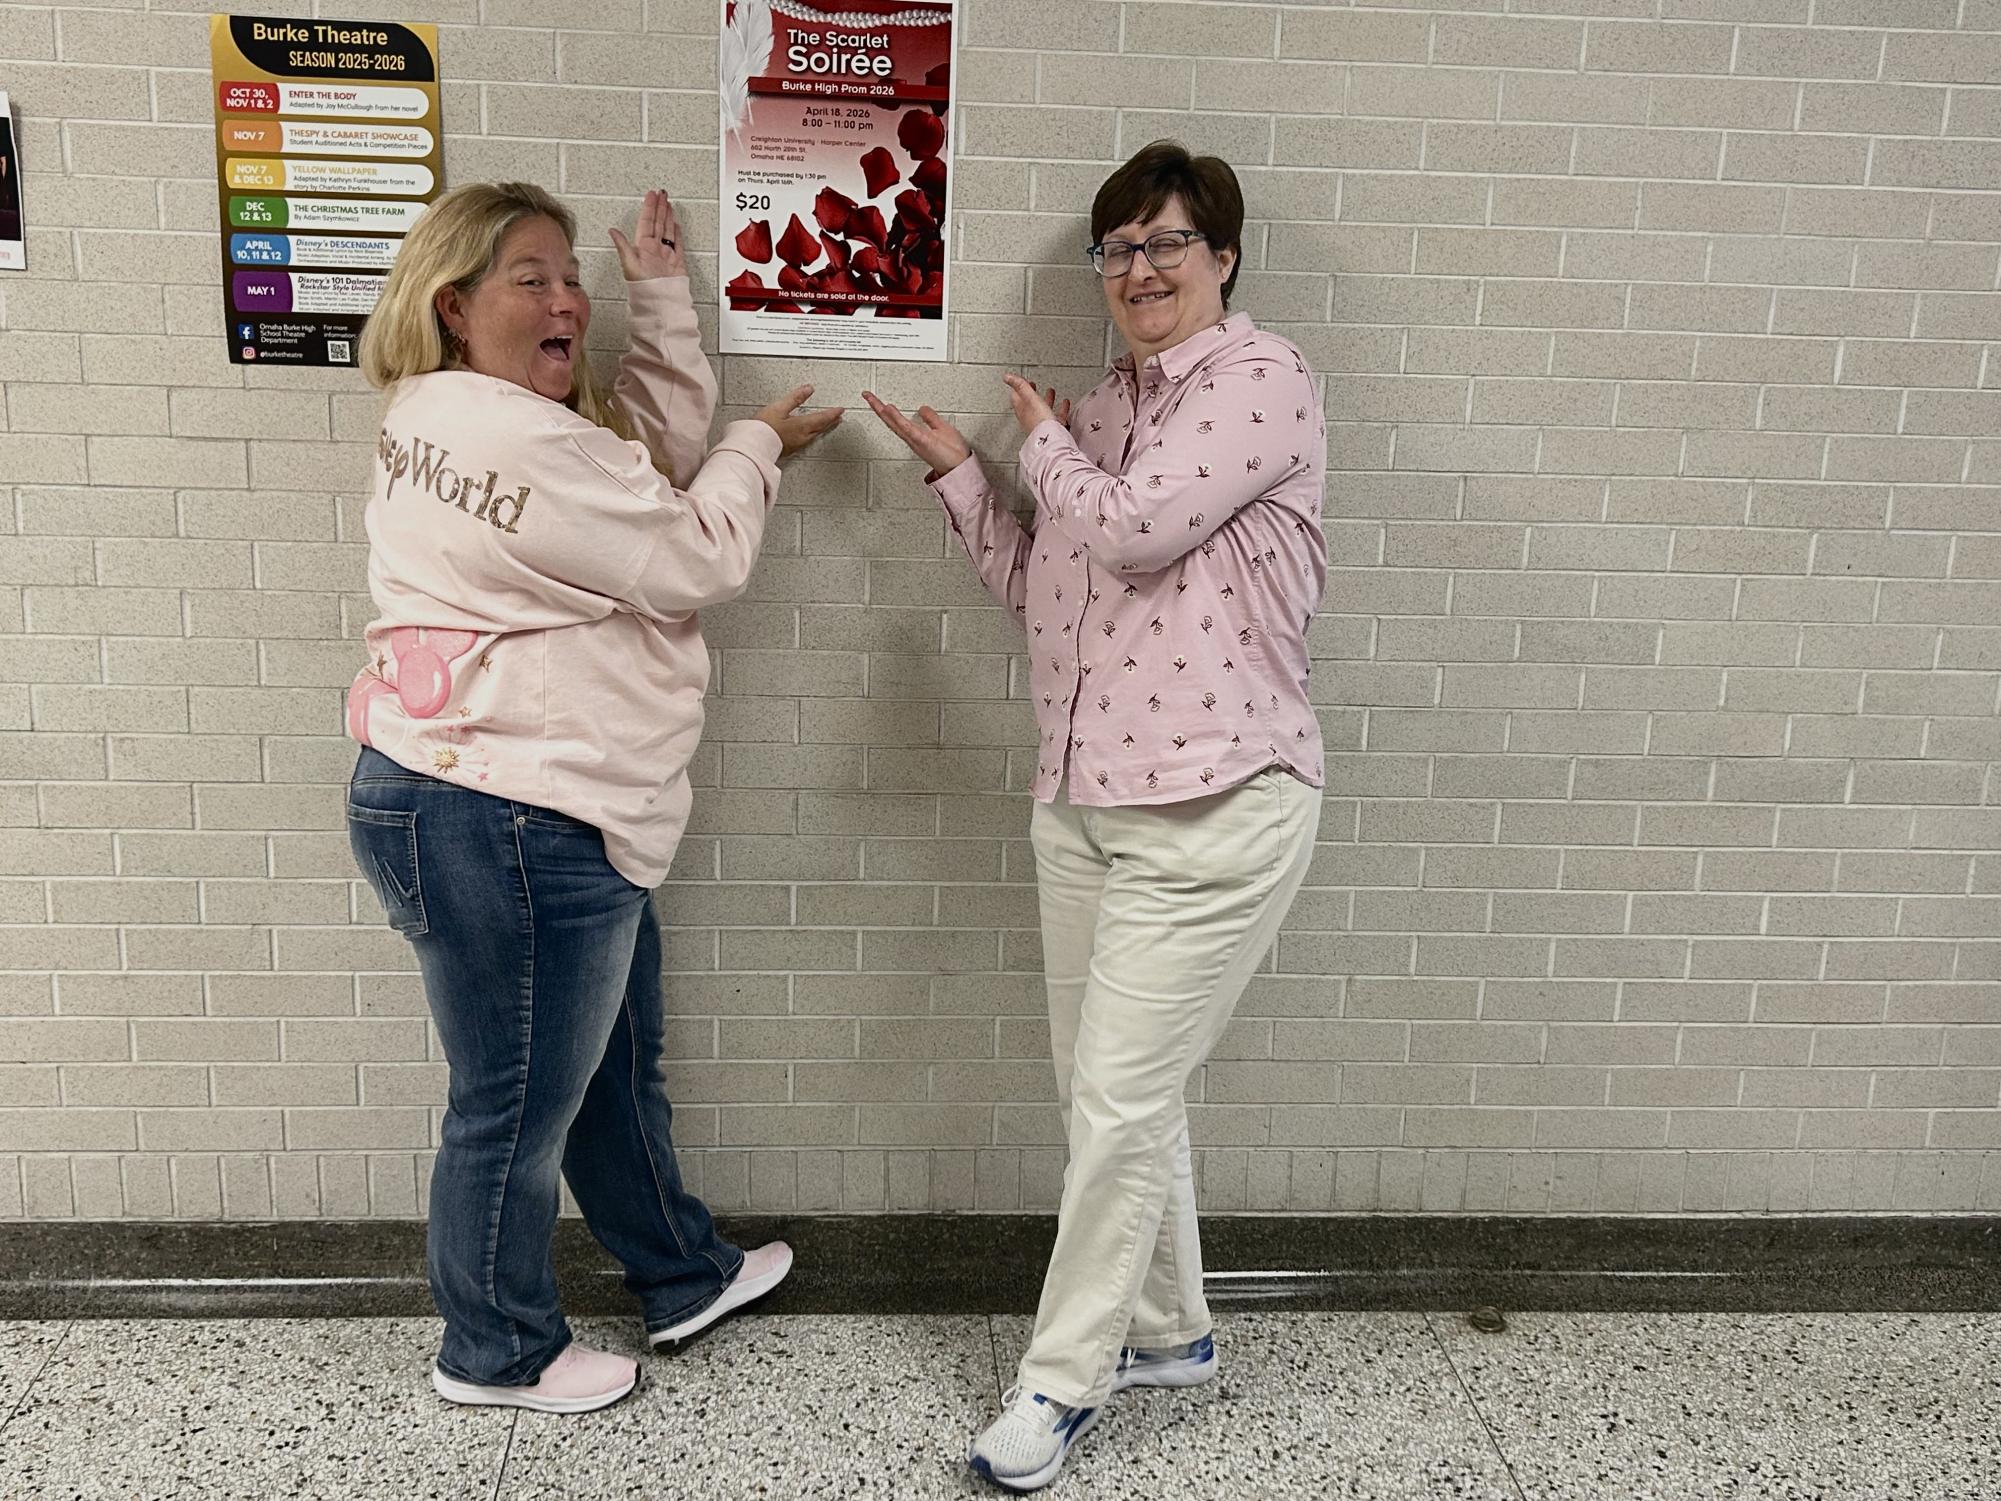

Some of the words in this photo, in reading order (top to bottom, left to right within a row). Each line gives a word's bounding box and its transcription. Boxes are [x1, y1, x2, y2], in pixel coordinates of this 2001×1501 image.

[253, 23, 309, 42] Burke
[314, 25, 388, 45] Theatre
[787, 29, 820, 45] The
[825, 31, 889, 48] Scarlet
[289, 50, 335, 68] SEASON
[338, 53, 405, 71] 2025-2026
[787, 46, 893, 77] Soirée
[230, 88, 251, 97] OCT
[253, 89, 269, 99] 30,
[782, 81, 812, 92] Burke
[815, 83, 839, 95] High
[841, 84, 867, 94] Prom
[870, 85, 895, 96] 2026
[289, 90, 314, 99] ENTER
[316, 91, 332, 100] THE
[334, 92, 357, 100] BODY
[226, 98, 249, 107] NOV
[250, 99, 255, 108] 1
[256, 100, 265, 108] &
[266, 100, 273, 109] 2
[289, 101, 315, 109] Adapted
[805, 107, 828, 117] April
[846, 109, 870, 118] 2026
[802, 118, 823, 128] 8:00
[834, 120, 855, 129] 11:00
[858, 122, 874, 131] pm
[233, 131, 256, 140] NOV
[258, 132, 265, 140] 7
[289, 129, 320, 138] THESPY
[322, 130, 329, 138] &
[331, 131, 369, 139] CABARET
[371, 132, 419, 141] SHOWCASE
[750, 136, 782, 144] Creighton
[784, 137, 815, 146] University
[821, 139, 842, 147] Harper
[236, 164, 258, 174] NOV
[260, 165, 267, 174] 7
[293, 165, 327, 174] YELLOW
[329, 167, 377, 175] WALLPAPER
[233, 176, 241, 184] &
[243, 176, 261, 184] DEC
[762, 171, 794, 179] purchased
[795, 172, 804, 180] by
[246, 202, 264, 210] DEC
[735, 192, 771, 212] $20
[294, 204, 309, 212] THE
[313, 205, 358, 214] CHRISTMAS
[361, 207, 379, 215] TREE
[382, 208, 405, 216] FARM
[240, 212, 250, 220] 12
[252, 213, 261, 221] &
[262, 212, 272, 221] 13
[245, 240, 272, 250] APRIL
[330, 240, 390, 250] DESCENDANTS
[236, 250, 250, 260] 10,
[252, 251, 260, 260] 11
[261, 251, 270, 260] &
[271, 251, 282, 260] 12
[247, 286, 269, 295] MAY
[270, 286, 275, 295] 1
[332, 284, 350, 292] Style
[301, 325, 316, 333] High
[412, 436, 531, 534] World
